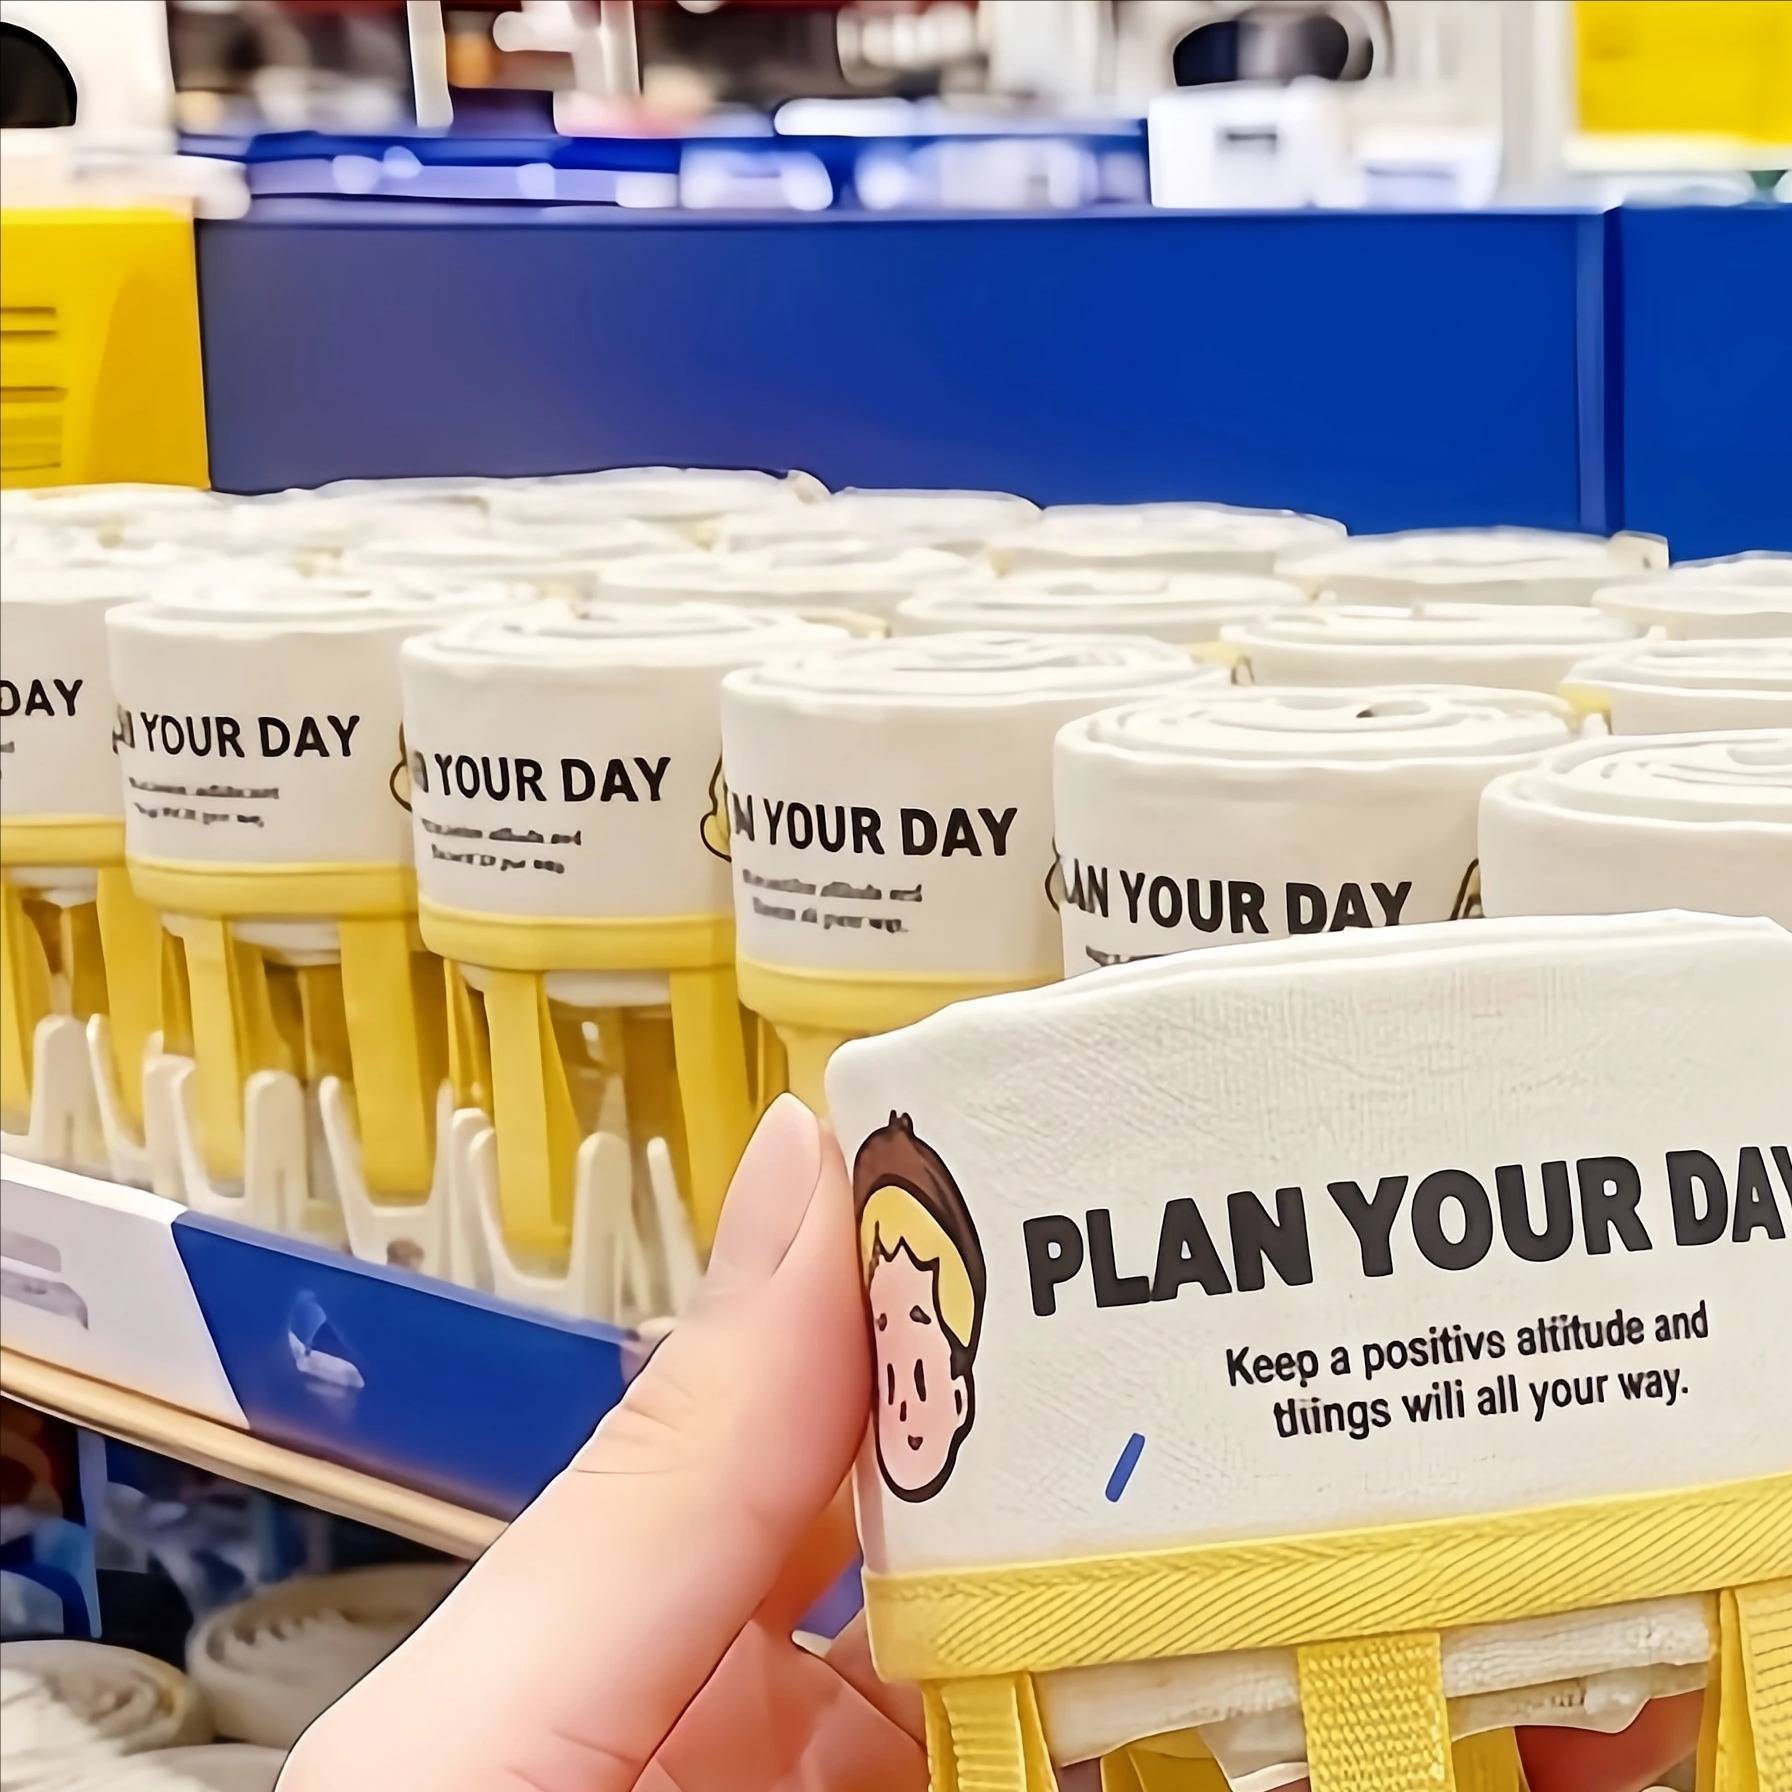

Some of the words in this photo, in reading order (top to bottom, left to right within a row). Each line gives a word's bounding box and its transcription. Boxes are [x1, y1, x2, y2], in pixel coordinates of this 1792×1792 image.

[0, 679, 83, 717] DAY
[140, 712, 246, 758] YOUR
[258, 715, 361, 757] DAY
[435, 753, 544, 801] YOUR
[561, 756, 672, 802] DAY
[763, 798, 885, 855] YOUR
[900, 807, 1018, 857] DAY
[1119, 869, 1270, 935] YOUR
[1285, 881, 1413, 935] DAY
[1023, 1187, 1314, 1318] PLAN
[1327, 1153, 1653, 1279] YOUR
[1226, 1346, 1320, 1389] Keep
[1331, 1346, 1351, 1376] a
[1655, 1299, 1709, 1342] and
[1477, 1374, 1519, 1416] all
[1529, 1374, 1609, 1422] your
[1617, 1367, 1689, 1407] way.
